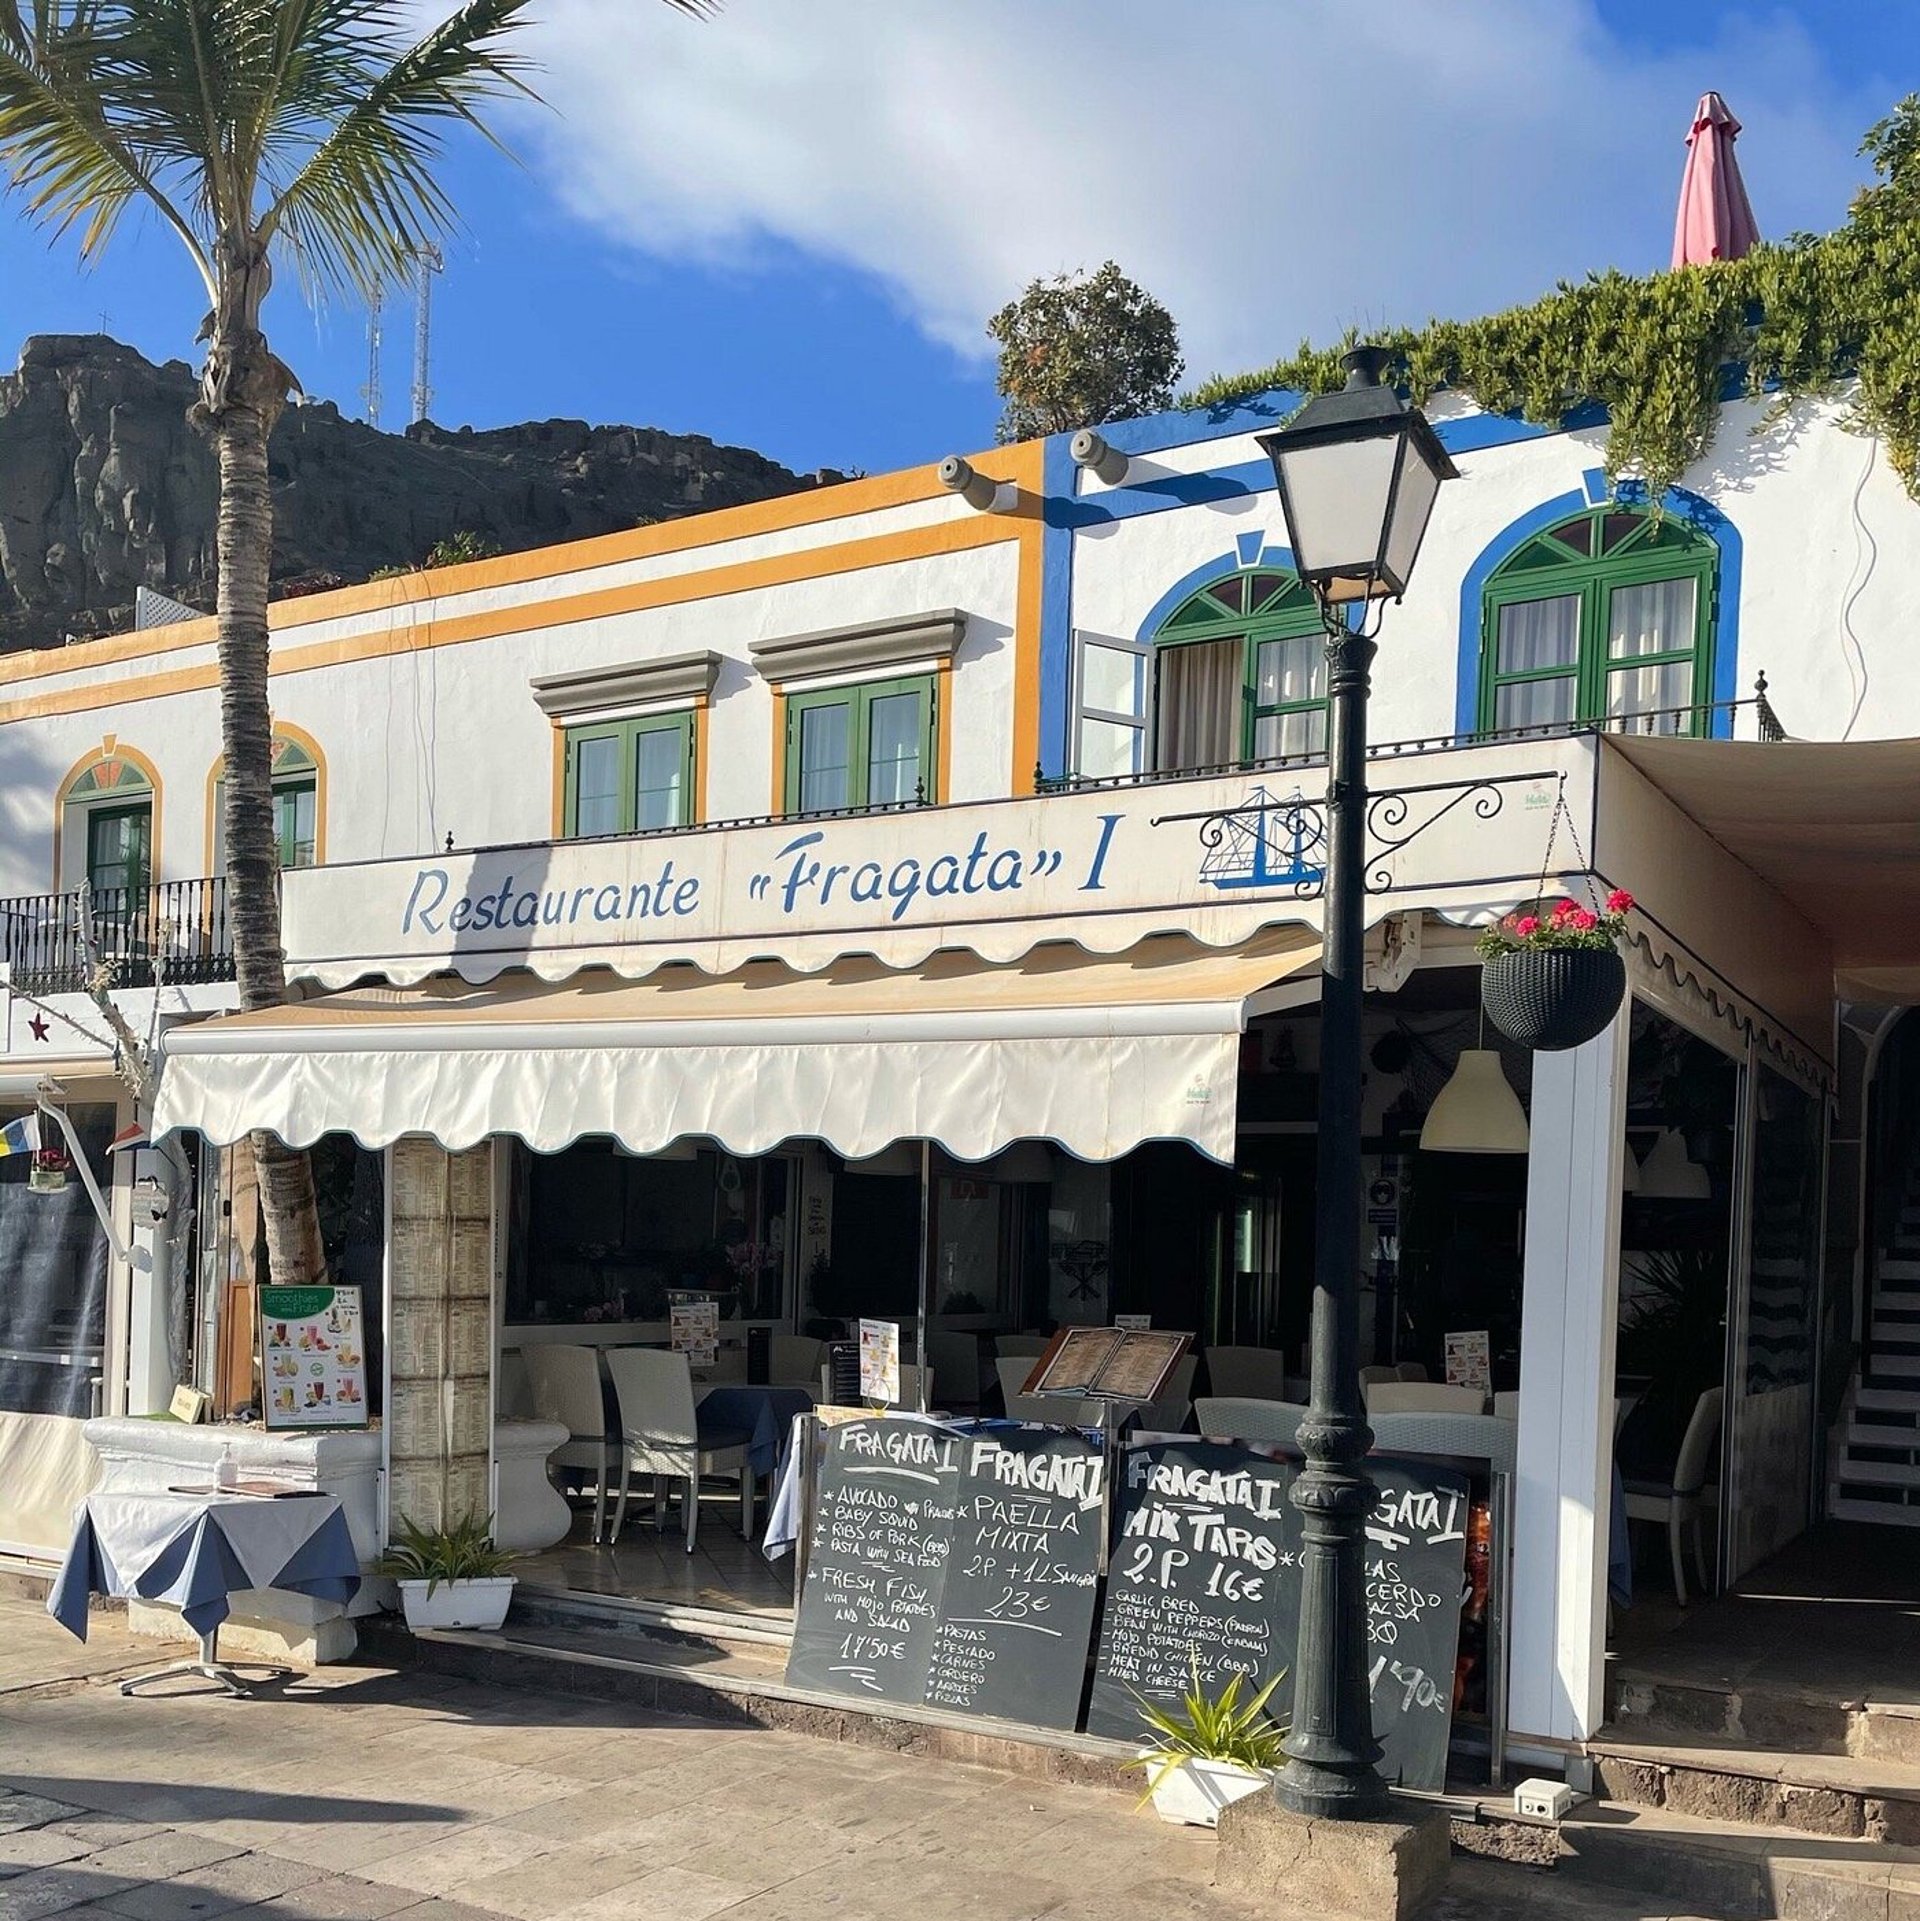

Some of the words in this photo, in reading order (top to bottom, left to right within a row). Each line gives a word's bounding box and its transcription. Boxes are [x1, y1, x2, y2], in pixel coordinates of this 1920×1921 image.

[403, 860, 700, 935] Restaurante
[1078, 813, 1127, 891] I
[839, 1424, 939, 1464] FRAGATA
[934, 1434, 960, 1473] I
[970, 1441, 1087, 1501] FRAGATA
[1128, 1451, 1256, 1512] FRAGATA
[837, 1485, 898, 1509] AVOCADO
[834, 1505, 873, 1527] BABY
[878, 1511, 918, 1531] SQUID
[974, 1495, 1080, 1535] PAELLA
[869, 1529, 884, 1541] OF
[887, 1528, 922, 1548] PORK
[975, 1526, 1050, 1554] MIXTA
[1187, 1513, 1278, 1571] TAPAS
[830, 1537, 861, 1556] PASTA
[893, 1548, 915, 1567] SEA
[822, 1566, 876, 1594] FRESH
[1205, 1562, 1266, 1602] 16€
[823, 1592, 849, 1605] WITH
[984, 1586, 1052, 1618] 23€
[1161, 1595, 1200, 1615] BRED
[1365, 1581, 1442, 1608] CERDO
[834, 1608, 859, 1623] AND
[866, 1612, 911, 1633] SALAD
[1116, 1602, 1161, 1620] GREEN
[1167, 1611, 1224, 1630] PEPPERS
[1366, 1600, 1421, 1623] ALSA
[944, 1624, 987, 1641] PASTAS
[1112, 1614, 1147, 1630] BEAN
[1152, 1622, 1179, 1635] WITH
[943, 1639, 996, 1661] PESCADO
[1111, 1628, 1140, 1646] MOJO
[1147, 1632, 1203, 1652] POTATOES
[940, 1653, 986, 1671] CARNES
[1109, 1653, 1141, 1671] MEAT
[1147, 1662, 1163, 1674] IN
[1163, 1650, 1214, 1668] CHICKEN
[937, 1666, 986, 1685] CORDERO
[1145, 1673, 1189, 1691] CHEESE
[934, 1690, 971, 1707] PIZZAS
